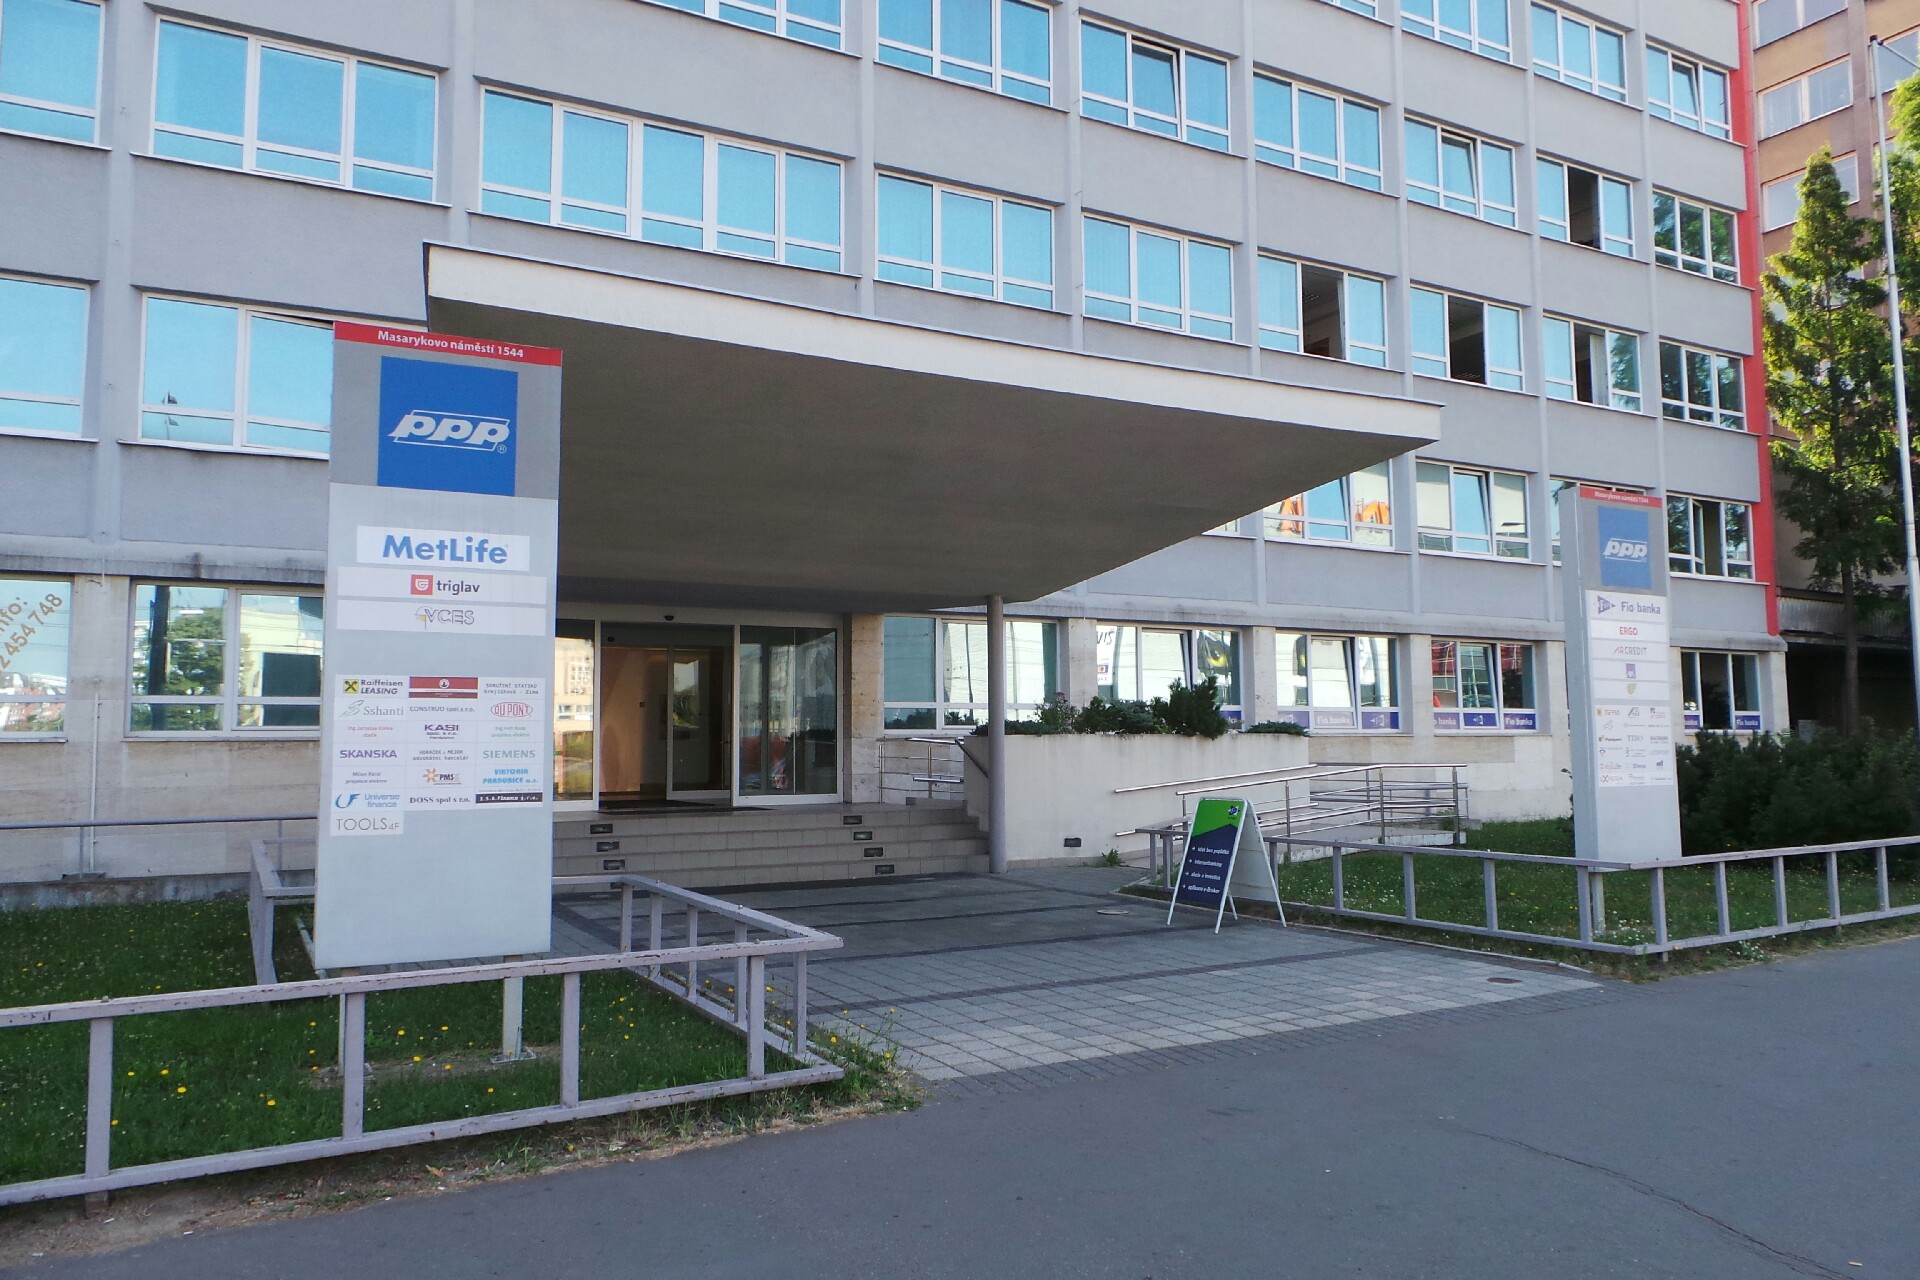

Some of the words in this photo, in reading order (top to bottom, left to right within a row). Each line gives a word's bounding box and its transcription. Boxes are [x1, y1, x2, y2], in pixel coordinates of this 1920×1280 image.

[377, 330, 448, 348] Masarykovo
[450, 340, 495, 354] náměstí
[497, 345, 524, 358] 1544
[382, 534, 508, 565] MetLife
[436, 579, 481, 595] triglav
[1621, 601, 1634, 613] Fio
[1636, 602, 1661, 614] banka
[424, 608, 475, 626] VCES
[1619, 626, 1638, 635] ERGO
[360, 679, 404, 687] Raiffeisen
[360, 687, 399, 695] LEASING
[363, 705, 405, 717] Sshanti
[339, 749, 398, 758] SKANSKA
[482, 749, 536, 759] SIEMENS
[409, 796, 434, 804] DOSS
